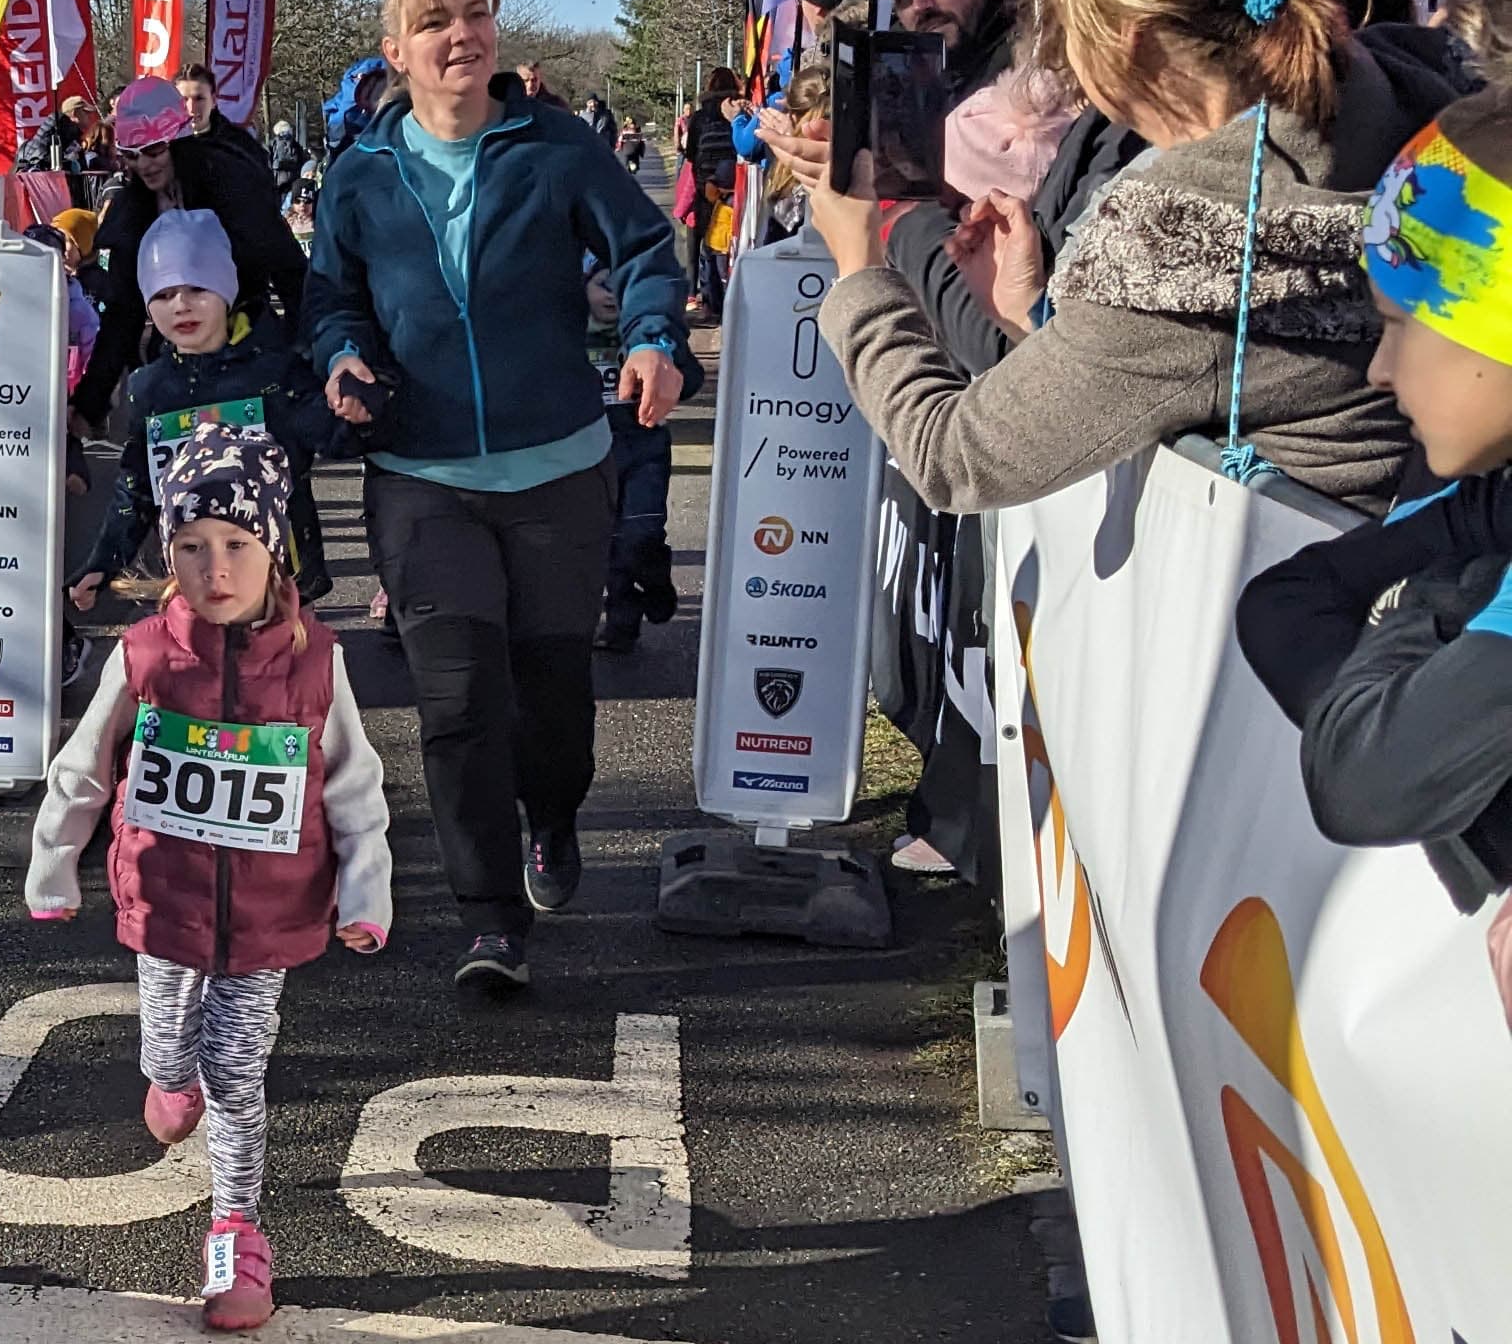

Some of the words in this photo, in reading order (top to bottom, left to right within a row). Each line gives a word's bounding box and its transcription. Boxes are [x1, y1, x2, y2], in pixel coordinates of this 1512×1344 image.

[749, 393, 852, 424] innogy
[778, 445, 849, 461] Powered
[776, 463, 796, 480] by
[803, 465, 847, 479] MVM
[801, 530, 829, 545] NN
[770, 580, 827, 599] ŠKODA
[759, 635, 818, 649] RUNTO
[740, 737, 808, 752] NUTREND
[135, 749, 287, 825] 3015
[215, 1243, 226, 1279] 3015
